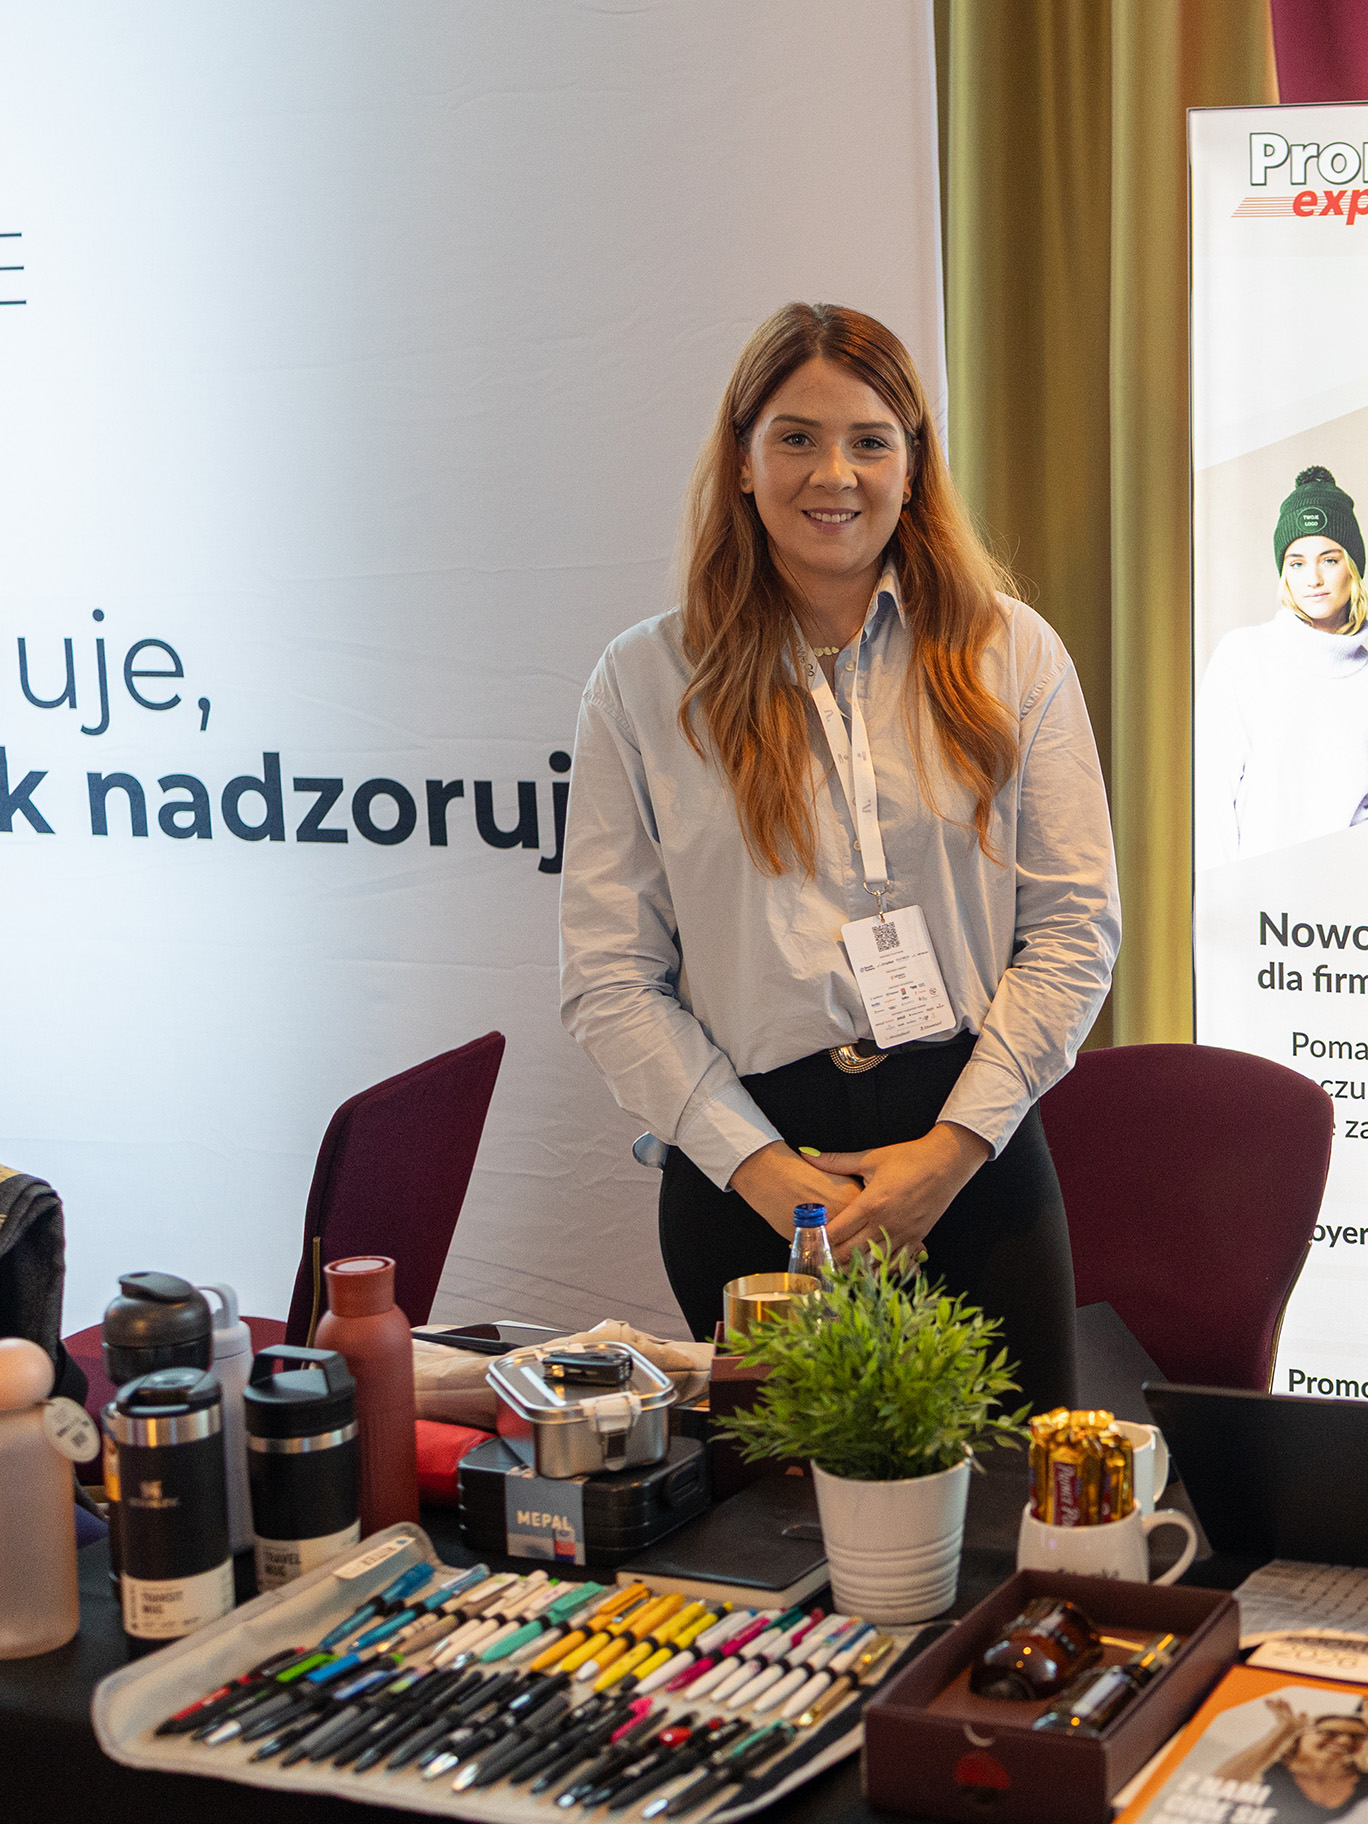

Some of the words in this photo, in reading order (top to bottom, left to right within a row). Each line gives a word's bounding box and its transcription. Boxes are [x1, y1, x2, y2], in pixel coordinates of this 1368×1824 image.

[17, 608, 211, 735] uje,
[87, 749, 572, 874] nadzoruj
[1257, 961, 1303, 991] dla
[516, 1510, 573, 1531] MEPAL
